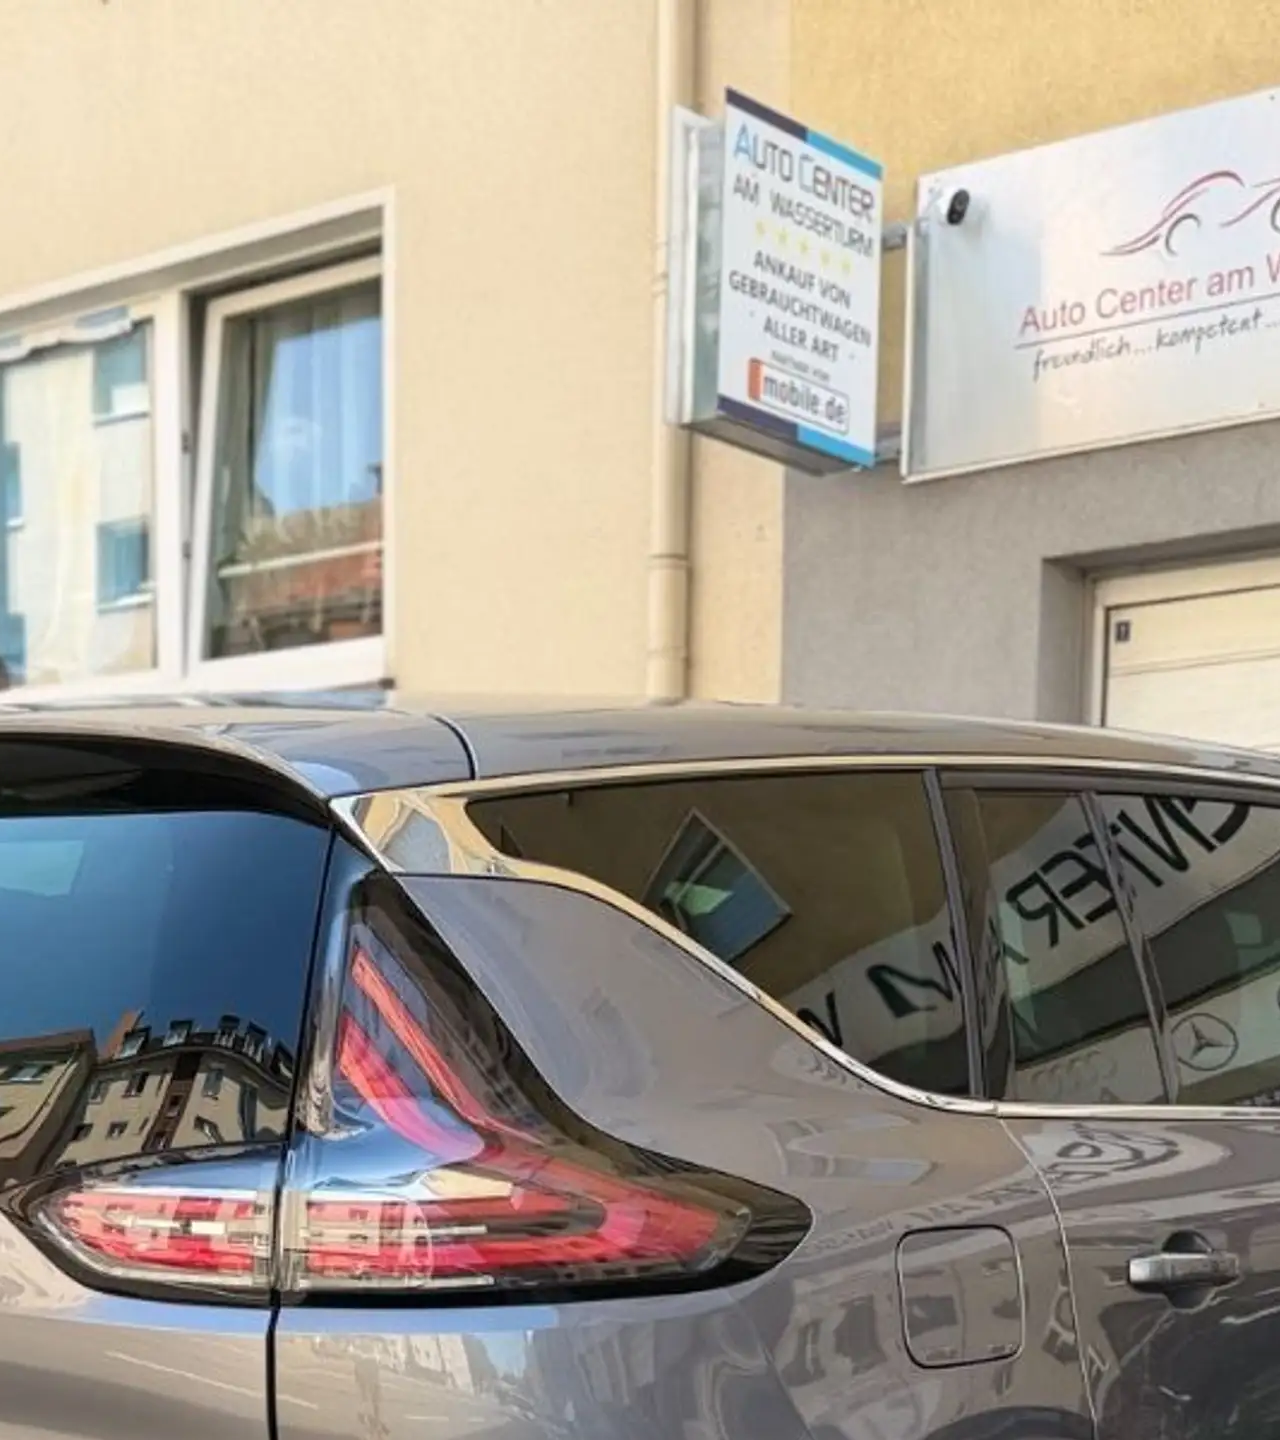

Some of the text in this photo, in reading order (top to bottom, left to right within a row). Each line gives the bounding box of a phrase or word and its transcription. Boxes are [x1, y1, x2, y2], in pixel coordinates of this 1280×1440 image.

[733, 122, 875, 224] AUTO CENTER
[733, 173, 874, 258] AM WASSERTURM
[728, 269, 872, 348] GEBRAUCHTWAGEN
[753, 250, 852, 310] ANKAUF VON
[1019, 301, 1086, 336] Auto
[1095, 278, 1198, 319] Center
[1206, 266, 1254, 297] am
[763, 315, 840, 362] ALLER ART
